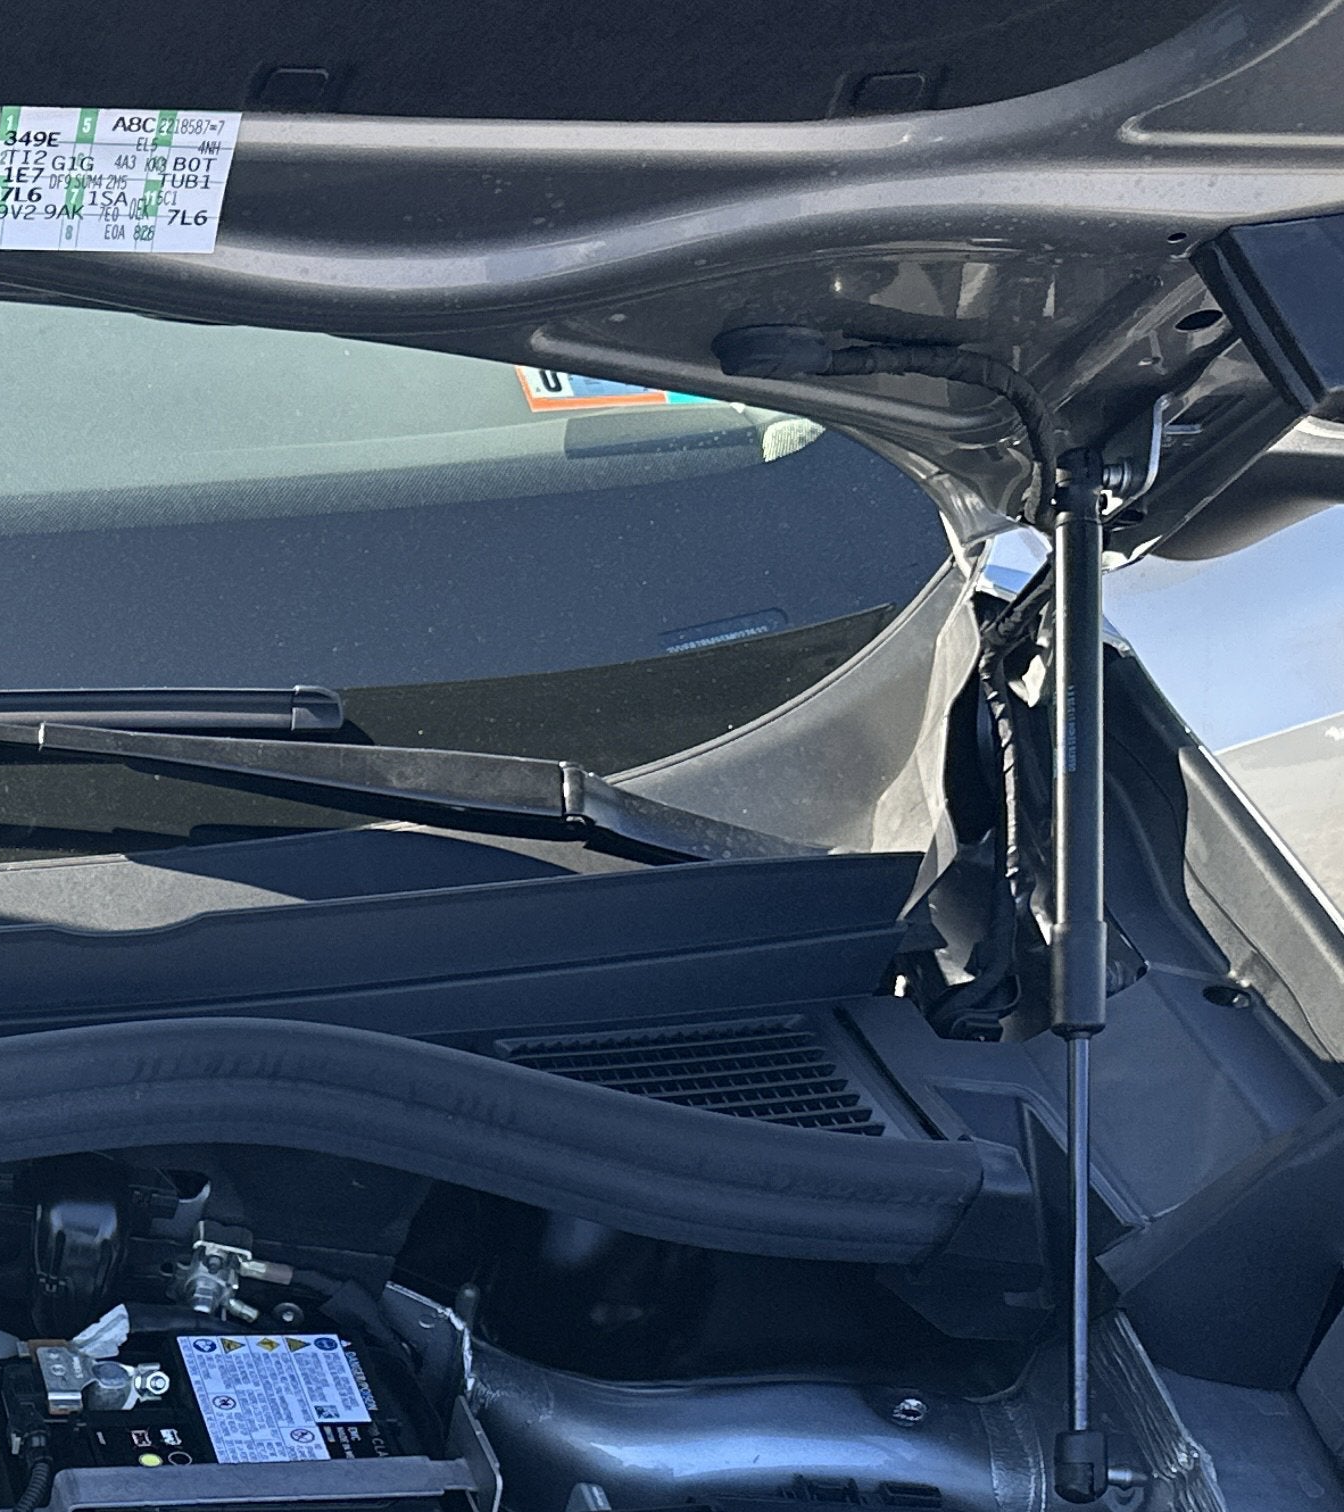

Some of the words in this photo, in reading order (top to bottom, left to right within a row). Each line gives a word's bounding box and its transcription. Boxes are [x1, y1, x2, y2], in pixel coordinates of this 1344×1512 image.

[112, 116, 156, 133] A8C
[4, 131, 61, 147] 349E
[114, 155, 137, 170] 4A3
[3, 166, 45, 183] 1E7
[1, 187, 43, 203] 7L6
[88, 191, 128, 206] 1SA
[44, 204, 85, 220] 9AK
[167, 209, 208, 226] 7L6
